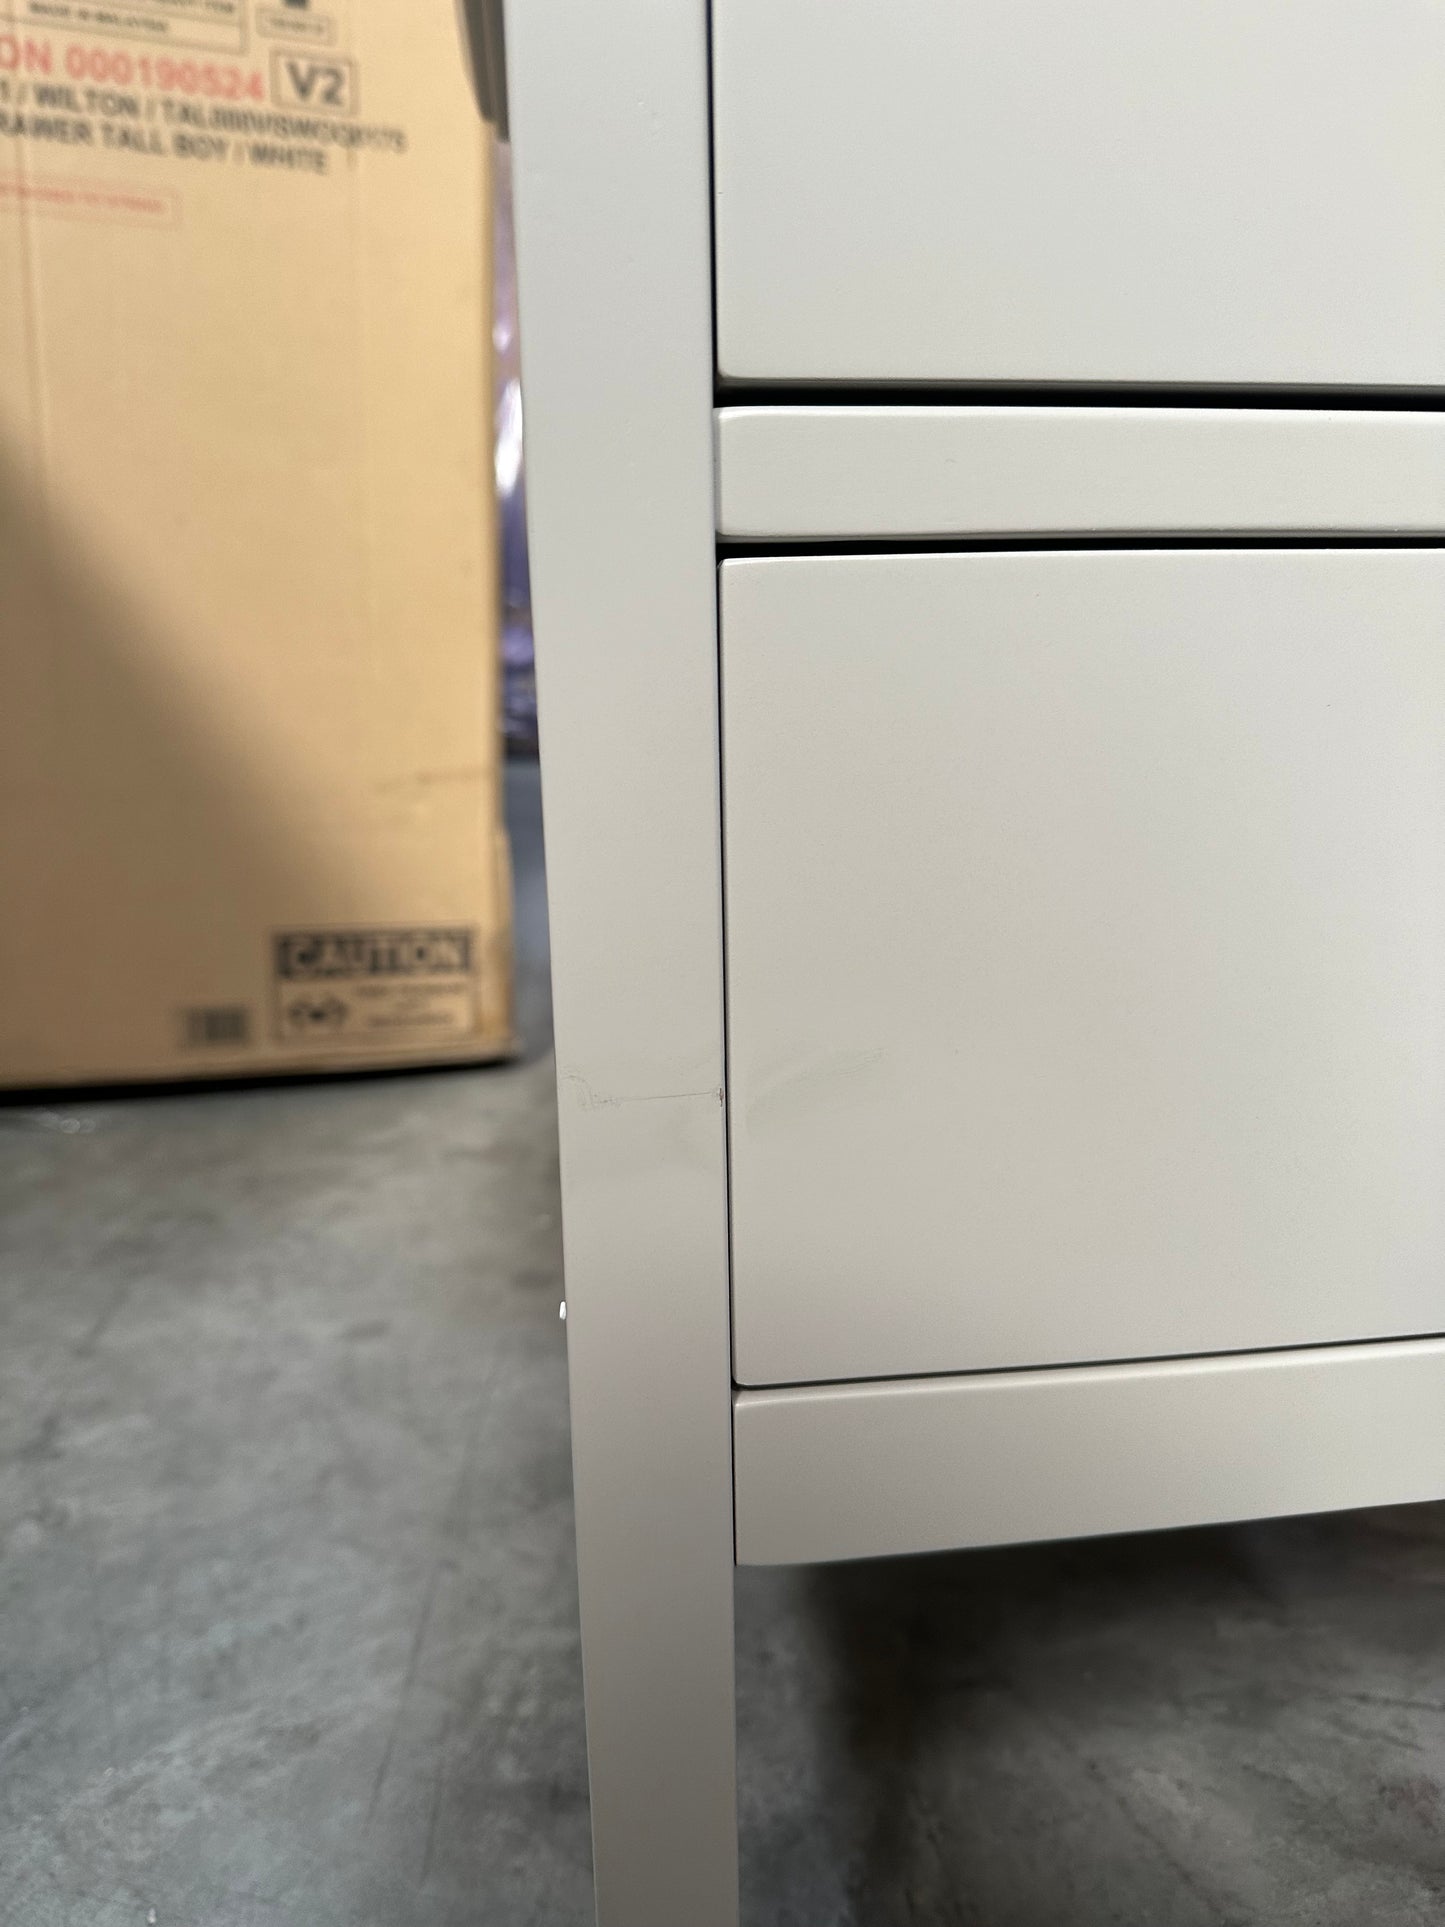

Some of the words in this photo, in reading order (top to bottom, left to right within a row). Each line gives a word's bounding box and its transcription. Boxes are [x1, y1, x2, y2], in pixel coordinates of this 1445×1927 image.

[34, 83, 139, 119] WILTON
[285, 60, 346, 106] V2
[101, 123, 165, 155] TALL
[172, 132, 230, 160] BOY
[249, 141, 328, 174] WHITE
[290, 932, 464, 976] CAUTION
